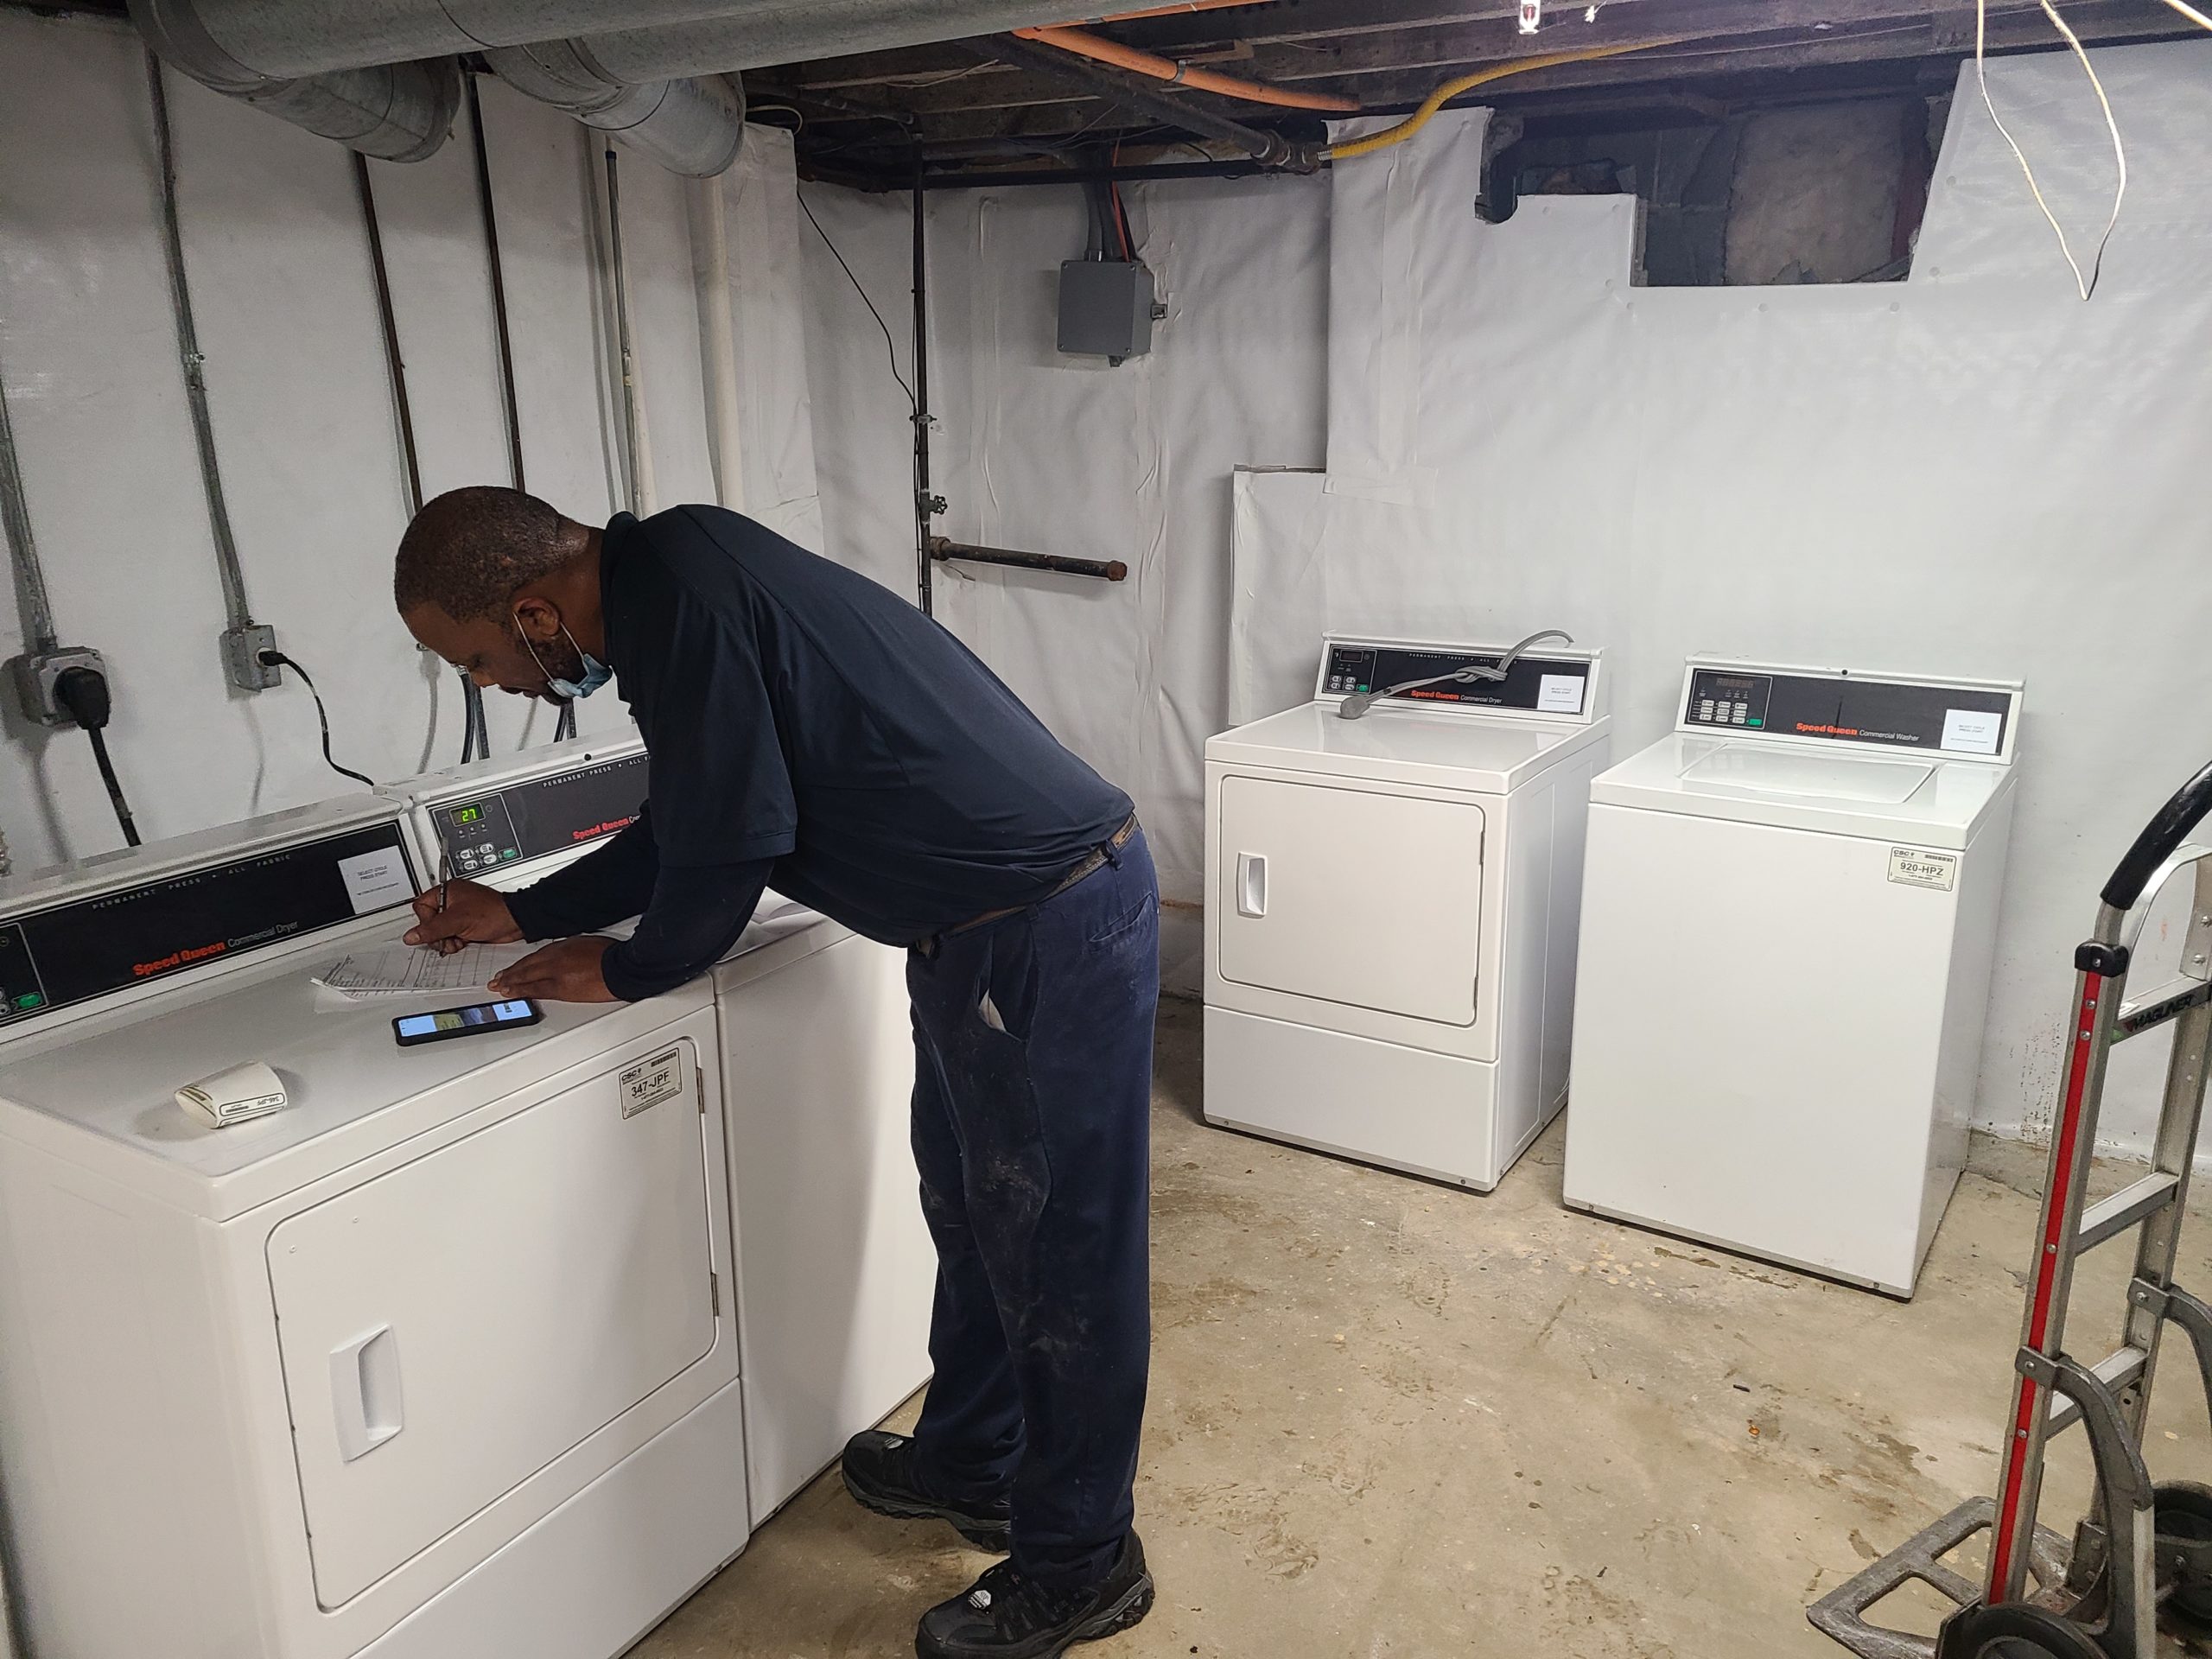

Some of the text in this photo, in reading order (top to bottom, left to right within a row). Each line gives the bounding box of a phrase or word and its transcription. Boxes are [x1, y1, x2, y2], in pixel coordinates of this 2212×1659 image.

[1411, 690, 1503, 706] Speed Queen Commercial Dryer
[1796, 722, 1920, 742] Speed Queen Commercial Washer
[543, 772, 586, 788] PERMANENT
[589, 766, 612, 777] PRESS
[628, 758, 642, 766] ALL
[461, 808, 478, 823] 27
[572, 825, 601, 840] Speed
[601, 817, 629, 831] Queen
[1900, 861, 1944, 876] 920-HPZ
[91, 853, 292, 911] PERMANENT PRESS ALL FABRIC
[133, 919, 299, 976] Speed Queen Commercial Dryer
[621, 1070, 637, 1081] CSC
[631, 1071, 670, 1096] 347-JPF
